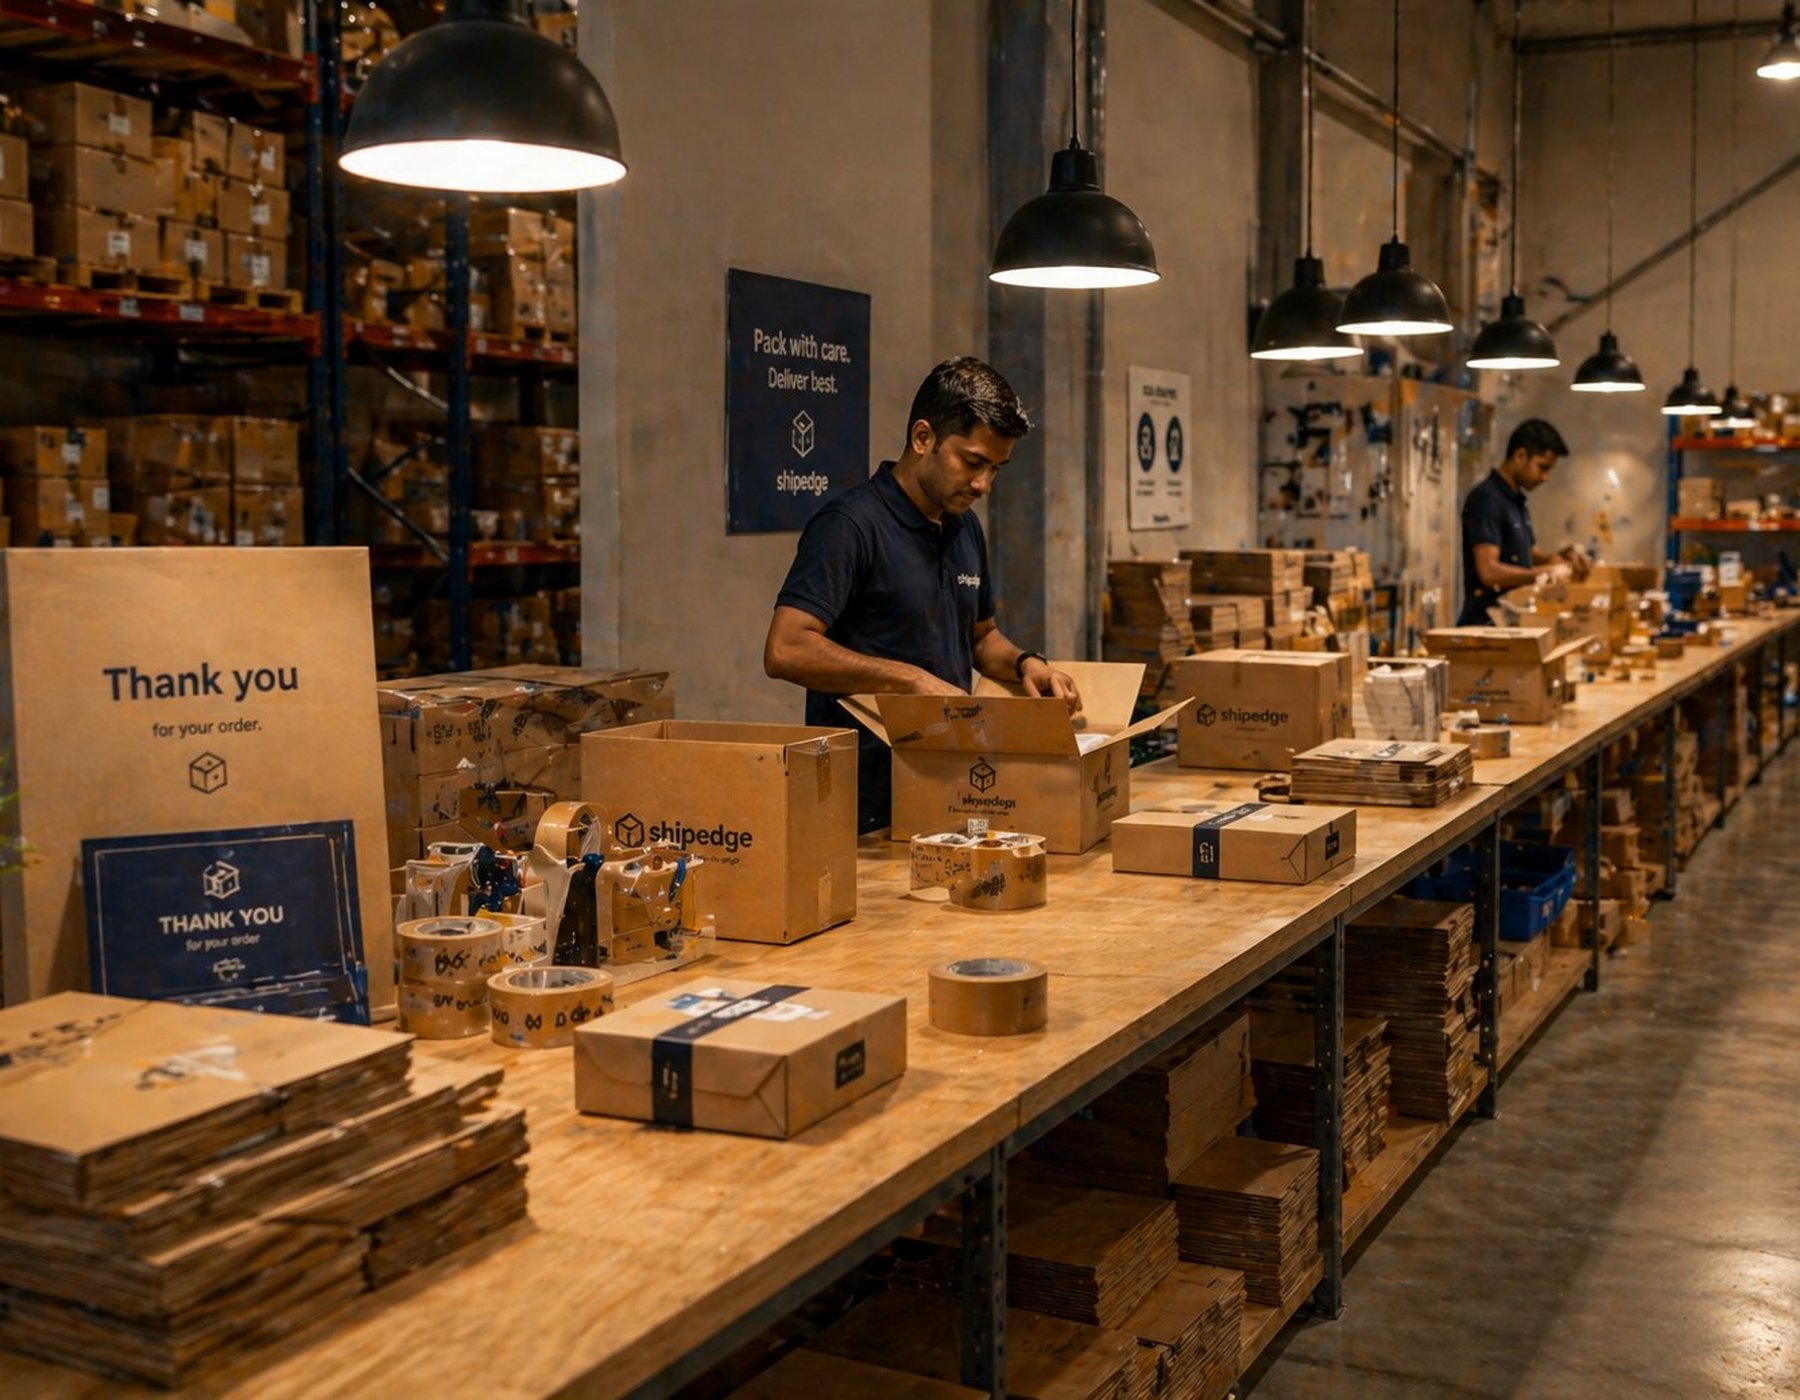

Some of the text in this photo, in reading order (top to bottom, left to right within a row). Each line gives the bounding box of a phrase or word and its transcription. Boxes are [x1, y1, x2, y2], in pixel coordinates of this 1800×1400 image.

[753, 327, 852, 364] Pack with care.
[767, 366, 839, 394] Deliver best.
[776, 468, 829, 497] shipedge
[102, 662, 299, 703] Thank you
[152, 716, 263, 740] for your order.
[1220, 707, 1289, 727] shipedge
[649, 820, 753, 853] shipedge
[158, 904, 284, 935] THANK YOU
[185, 933, 261, 952] for your order
